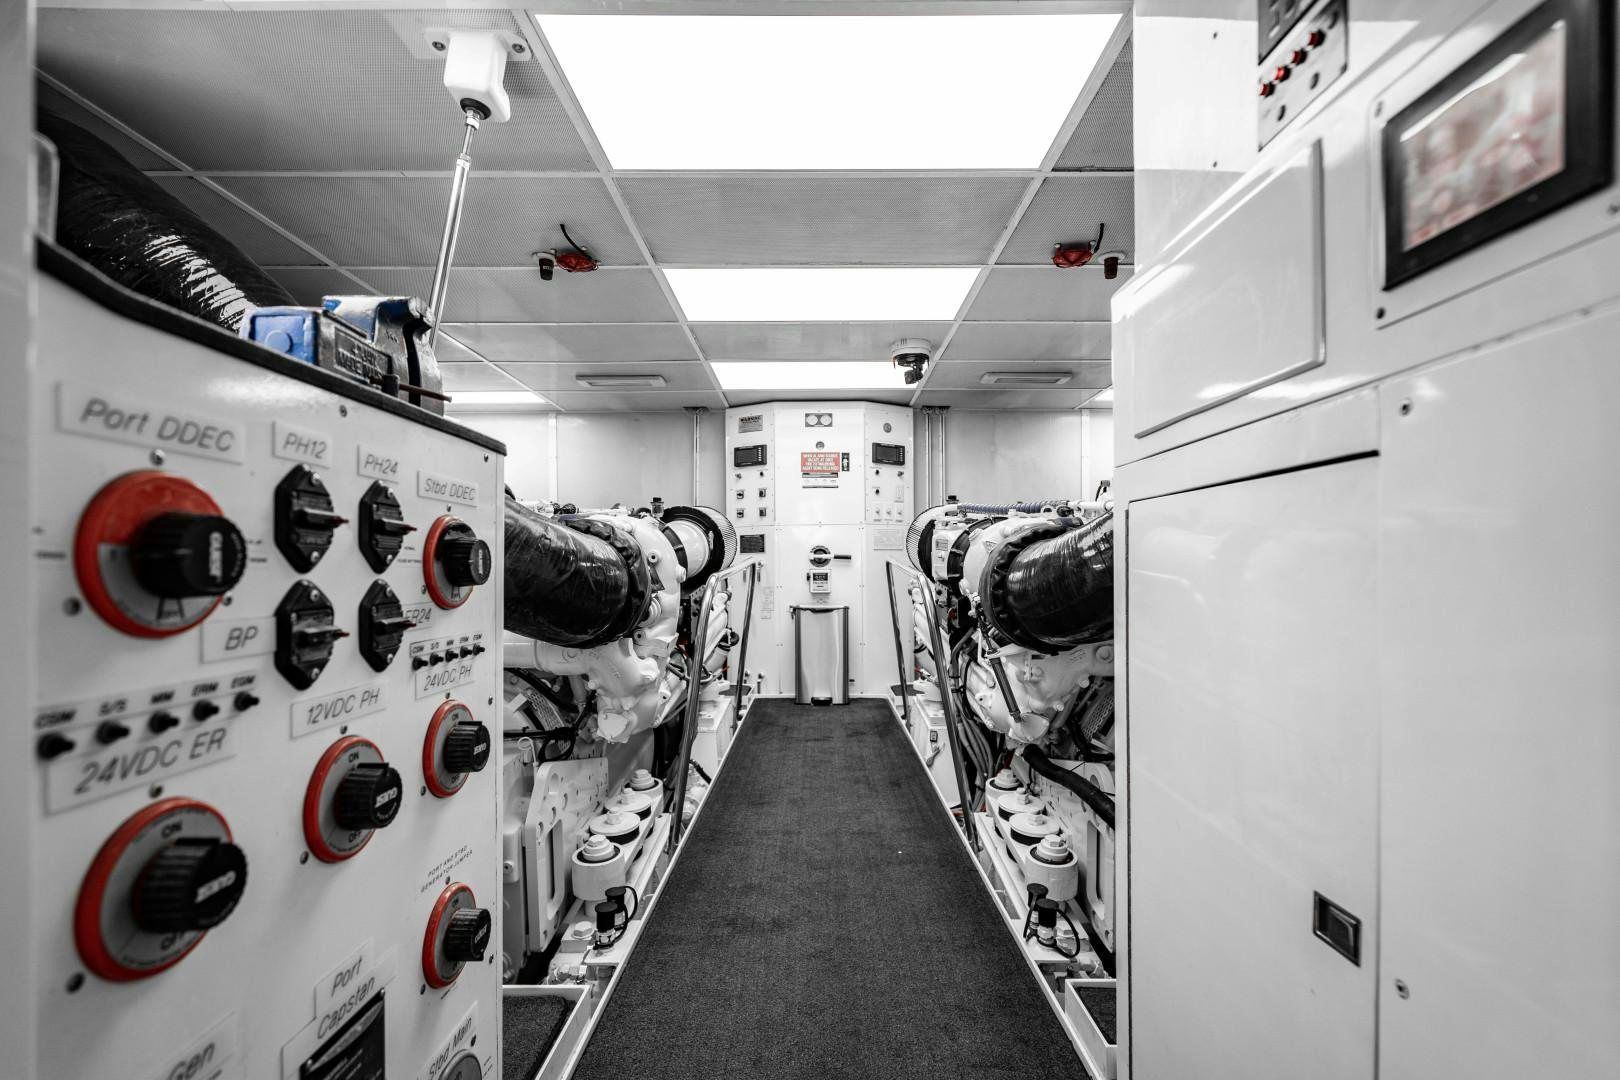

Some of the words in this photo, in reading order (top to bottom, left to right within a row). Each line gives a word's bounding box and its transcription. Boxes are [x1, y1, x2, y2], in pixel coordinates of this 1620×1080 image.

[80, 397, 150, 436] Port
[157, 416, 236, 453] DDEC
[283, 434, 327, 460] PH12
[364, 453, 398, 475] PH24
[424, 478, 447, 495] Stbd
[449, 483, 476, 501] DDEC
[224, 625, 259, 651] BP
[424, 668, 457, 691] 24VDC
[459, 665, 472, 680] PH
[307, 695, 356, 725] 12VDC
[360, 688, 380, 710] PH
[74, 740, 182, 795] 24VDC
[189, 727, 227, 760] ER
[348, 752, 359, 763] ON
[161, 820, 183, 838] ON
[428, 862, 442, 878] PORT
[331, 955, 363, 997] Port
[317, 976, 375, 1040] Capstan
[429, 1045, 450, 1076] Stbd
[453, 1017, 472, 1048] Main
